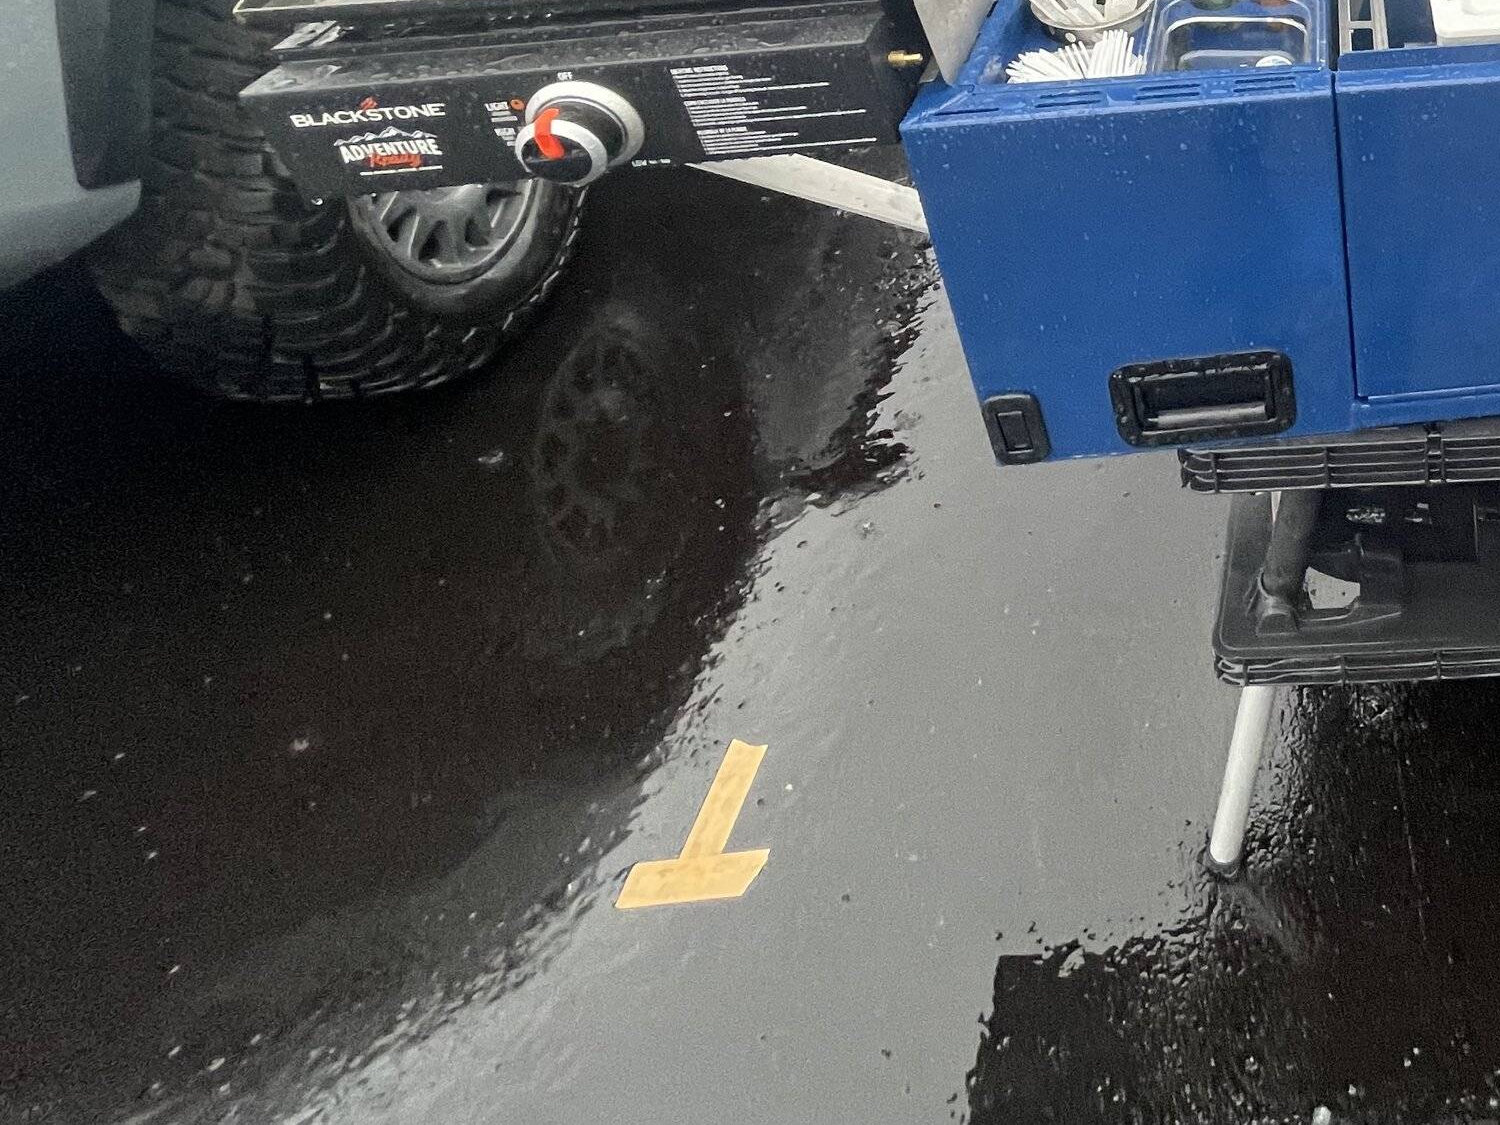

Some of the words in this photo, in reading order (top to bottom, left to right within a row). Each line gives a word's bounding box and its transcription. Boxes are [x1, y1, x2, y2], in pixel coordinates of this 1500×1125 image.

[557, 71, 573, 81] OFF
[289, 103, 446, 128] BLACKSTONE
[339, 138, 443, 164] ADVENTURE
